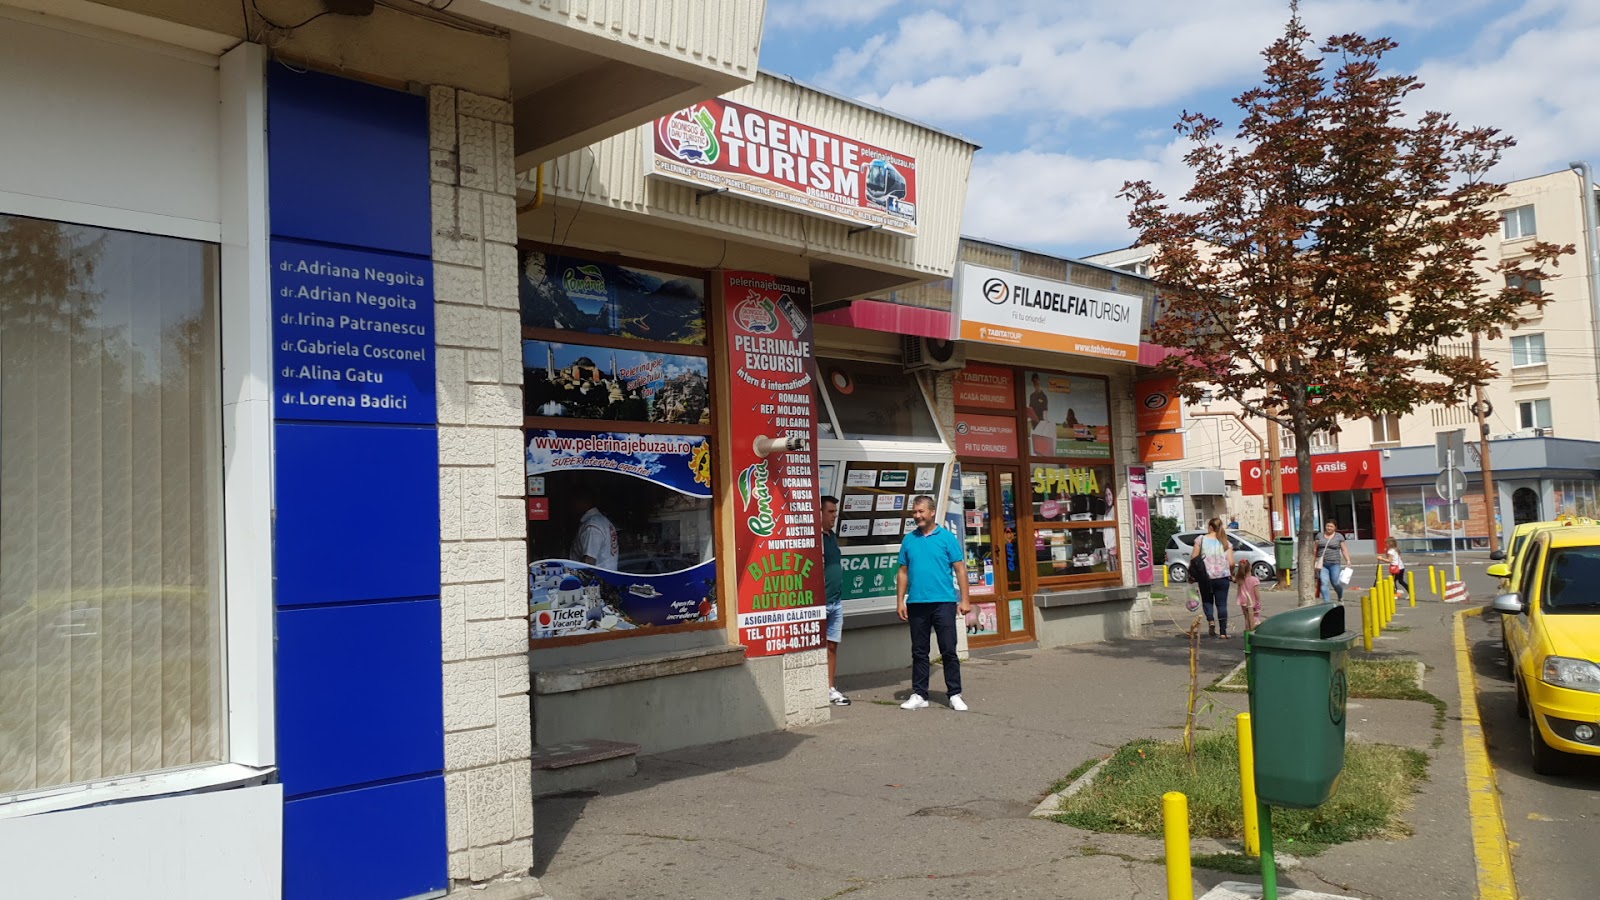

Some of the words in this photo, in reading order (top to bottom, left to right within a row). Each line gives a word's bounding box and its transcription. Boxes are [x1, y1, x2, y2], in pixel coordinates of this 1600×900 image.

[671, 120, 699, 135] DIONISOS
[700, 128, 705, 136] &
[683, 133, 706, 145] TURISTIC
[721, 134, 859, 198] TURISM
[861, 147, 916, 170] pelerinajebuzau.ro
[660, 162, 692, 176] PELERINAJE
[697, 170, 720, 183] EXCURSII
[724, 178, 746, 190] PACHETE
[746, 183, 770, 196] TURISTICE
[806, 186, 860, 207] ORGANIZATOARE
[280, 259, 360, 280] dr.Adriana
[364, 267, 425, 287] Negoita
[729, 277, 806, 296] pelerinajebuzau.ro
[280, 285, 351, 303] dr.Adrian
[356, 291, 417, 310] Negoita
[1013, 285, 1130, 324] FILADELFIATURISM
[280, 312, 335, 328] dr.Irina
[340, 315, 426, 336] Patranescu
[1020, 312, 1025, 320] tu
[1025, 313, 1046, 324] oriunde!
[988, 328, 1022, 340] TABITATOUR
[281, 339, 360, 357] dr.Gabriela
[363, 344, 426, 361] Cosconel
[735, 334, 810, 358] PELERINAJE
[1074, 343, 1127, 358] www.tabitatour.ro
[745, 353, 803, 374] EXCURSII
[282, 365, 341, 381] dr.Alina
[346, 368, 383, 384] Gatu
[736, 366, 759, 388] intern
[760, 379, 766, 389] &
[768, 372, 812, 391] international
[964, 372, 1008, 384] TABITATOUR
[282, 391, 356, 408] dr.Lorena
[360, 394, 407, 409] Badici
[778, 392, 810, 404] ROMANIA
[760, 404, 776, 414] REP.
[777, 404, 810, 416] MOLDOVA
[776, 416, 810, 428] BULGARIA
[534, 435, 691, 456] www.pelerinajebuzau.ro
[980, 444, 1007, 453] ORIUNDE!
[551, 457, 582, 468] SUPER
[584, 454, 618, 470] ofertele
[786, 453, 811, 464] TURCIA
[786, 466, 811, 476] GRECIA
[782, 477, 812, 488] UCRAINA
[1034, 468, 1100, 494] SPANIA
[792, 490, 813, 500] RUSIA
[790, 502, 814, 512] ISRAEL
[784, 514, 814, 524] UNGARIA
[786, 526, 815, 537] AUSTRIA
[768, 537, 816, 550] MUNTENEGRU
[746, 552, 814, 582] BILETE
[840, 556, 870, 570] RCA
[874, 555, 898, 569] IEF
[763, 574, 803, 593] AVION
[752, 589, 814, 610] AUTOCAR
[552, 608, 585, 621] Ticket
[746, 628, 764, 641] TEL.
[765, 621, 820, 640] 0771-15.14.95
[766, 634, 821, 652] 0764-40.71.84
